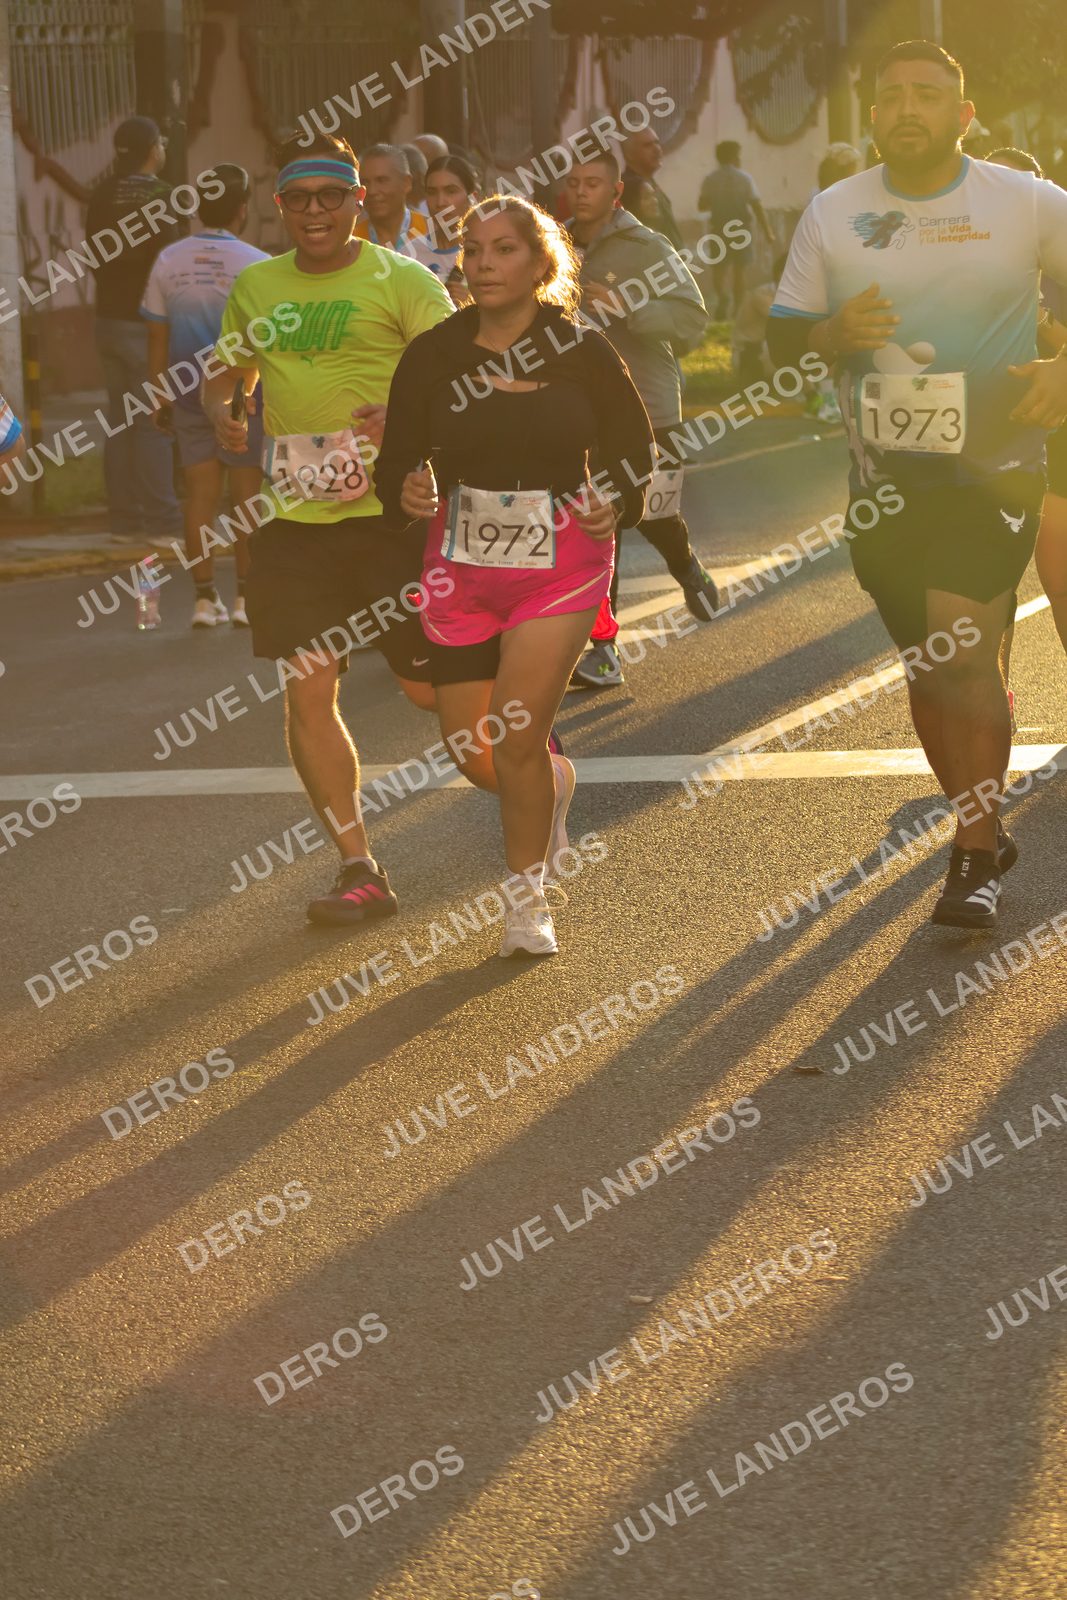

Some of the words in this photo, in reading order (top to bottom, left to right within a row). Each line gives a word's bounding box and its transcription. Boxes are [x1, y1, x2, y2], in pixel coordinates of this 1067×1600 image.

[919, 214, 970, 227] Carrera
[948, 223, 971, 233] Vida
[938, 231, 990, 243] Integridad
[868, 407, 962, 443] 1973
[462, 519, 549, 557] 1972
